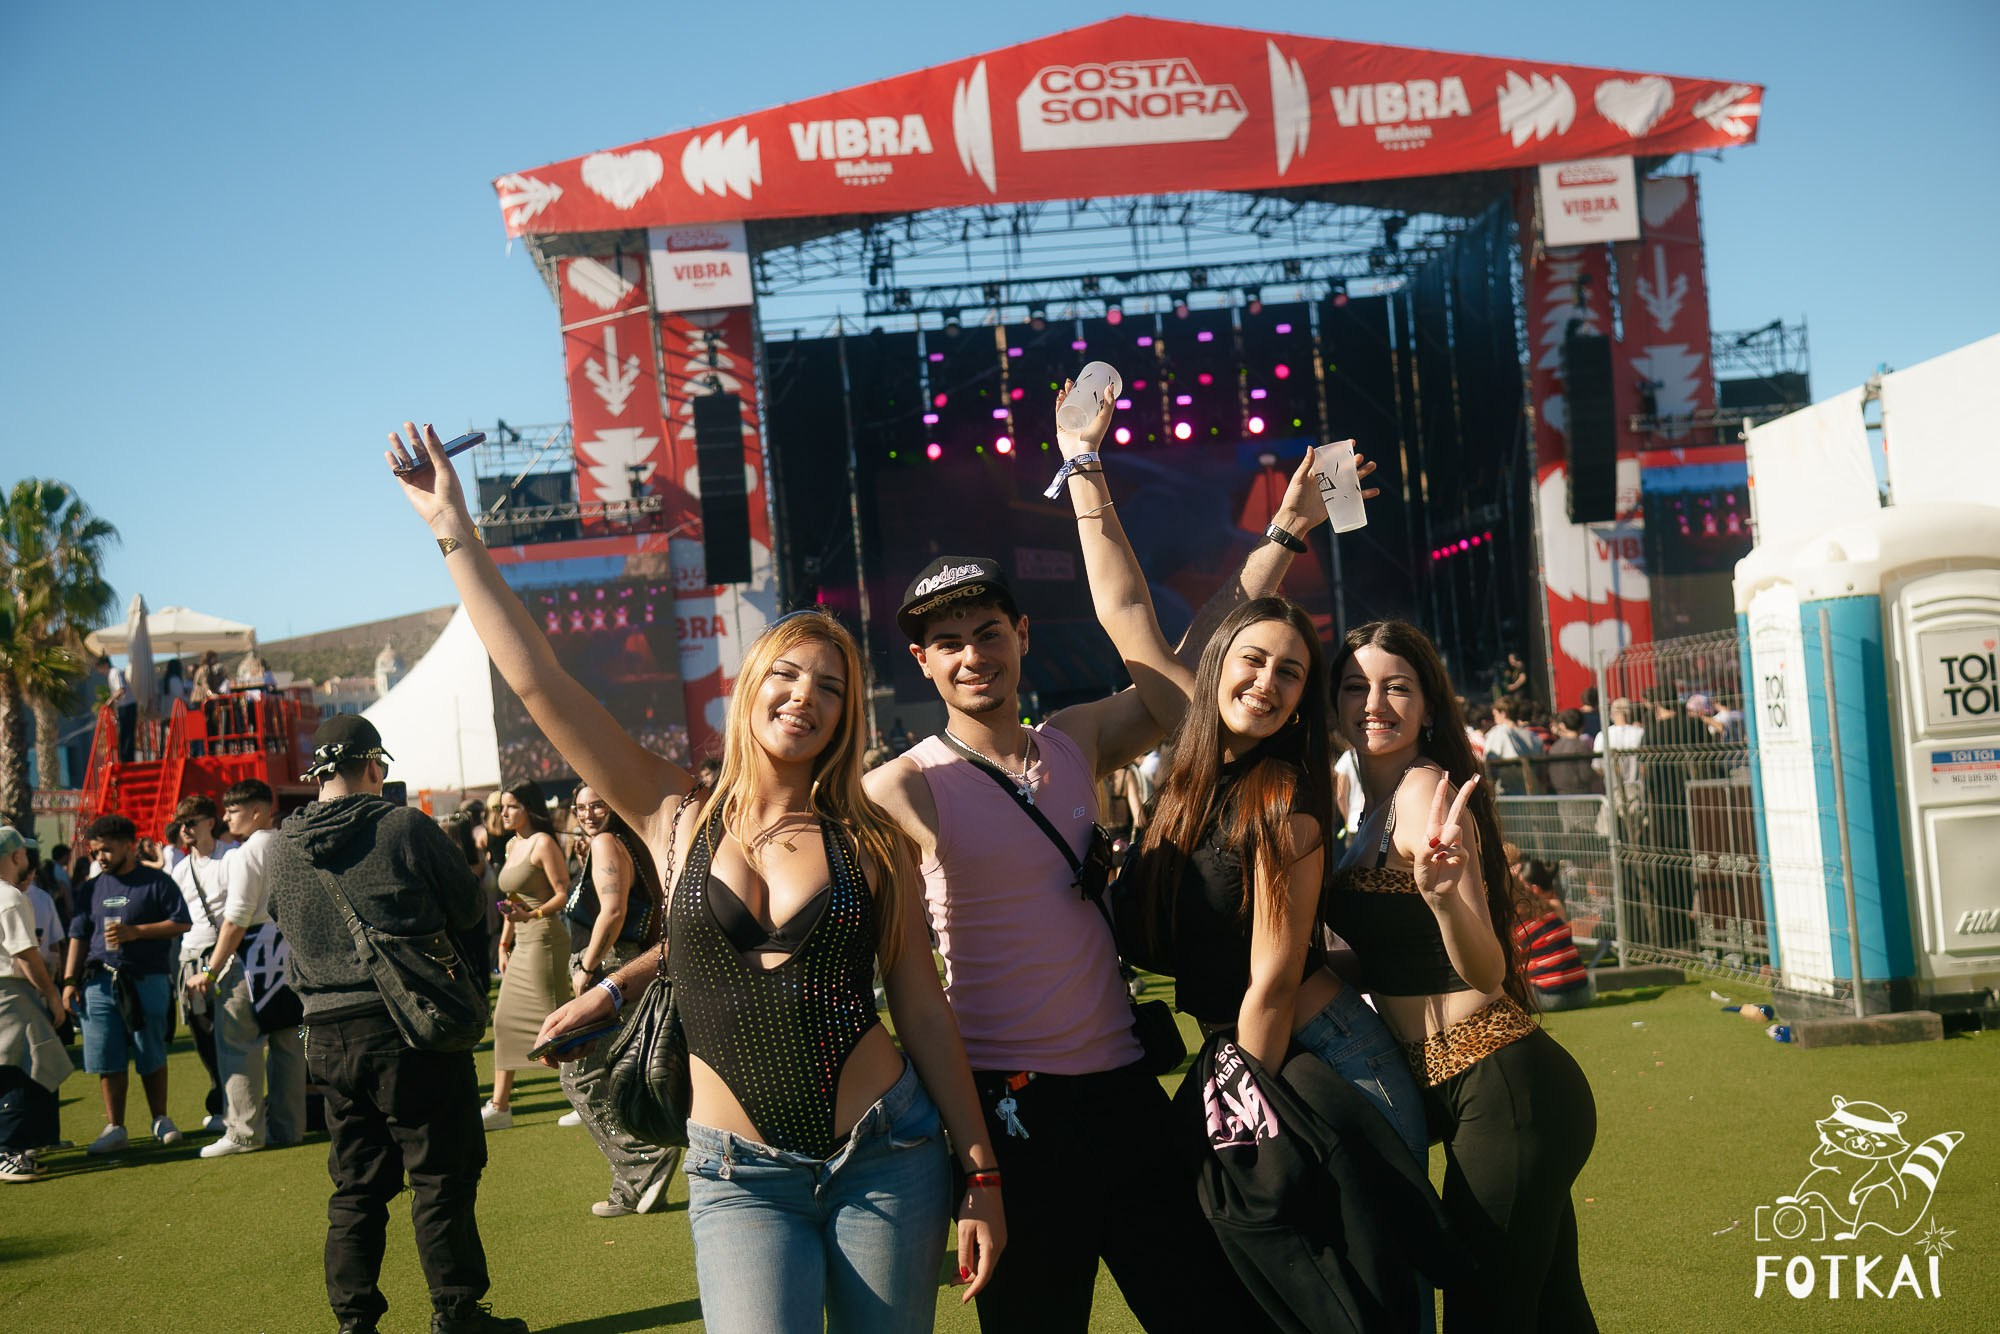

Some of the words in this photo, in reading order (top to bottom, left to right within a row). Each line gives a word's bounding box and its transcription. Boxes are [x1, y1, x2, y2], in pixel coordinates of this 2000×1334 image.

[1039, 62, 1198, 95] COSTA
[1040, 89, 1242, 125] SONORA
[1330, 75, 1472, 127] VIBRA
[789, 113, 934, 162] VIBRA
[1562, 195, 1620, 216] VIBRA
[673, 261, 732, 281] VIBRA
[1596, 537, 1643, 561] VIB
[914, 563, 985, 597] Dodgers
[676, 614, 728, 640] BRA
[1940, 653, 1997, 685] TOI
[1944, 685, 2000, 716] TOI
[1215, 1055, 1245, 1089] NEW
